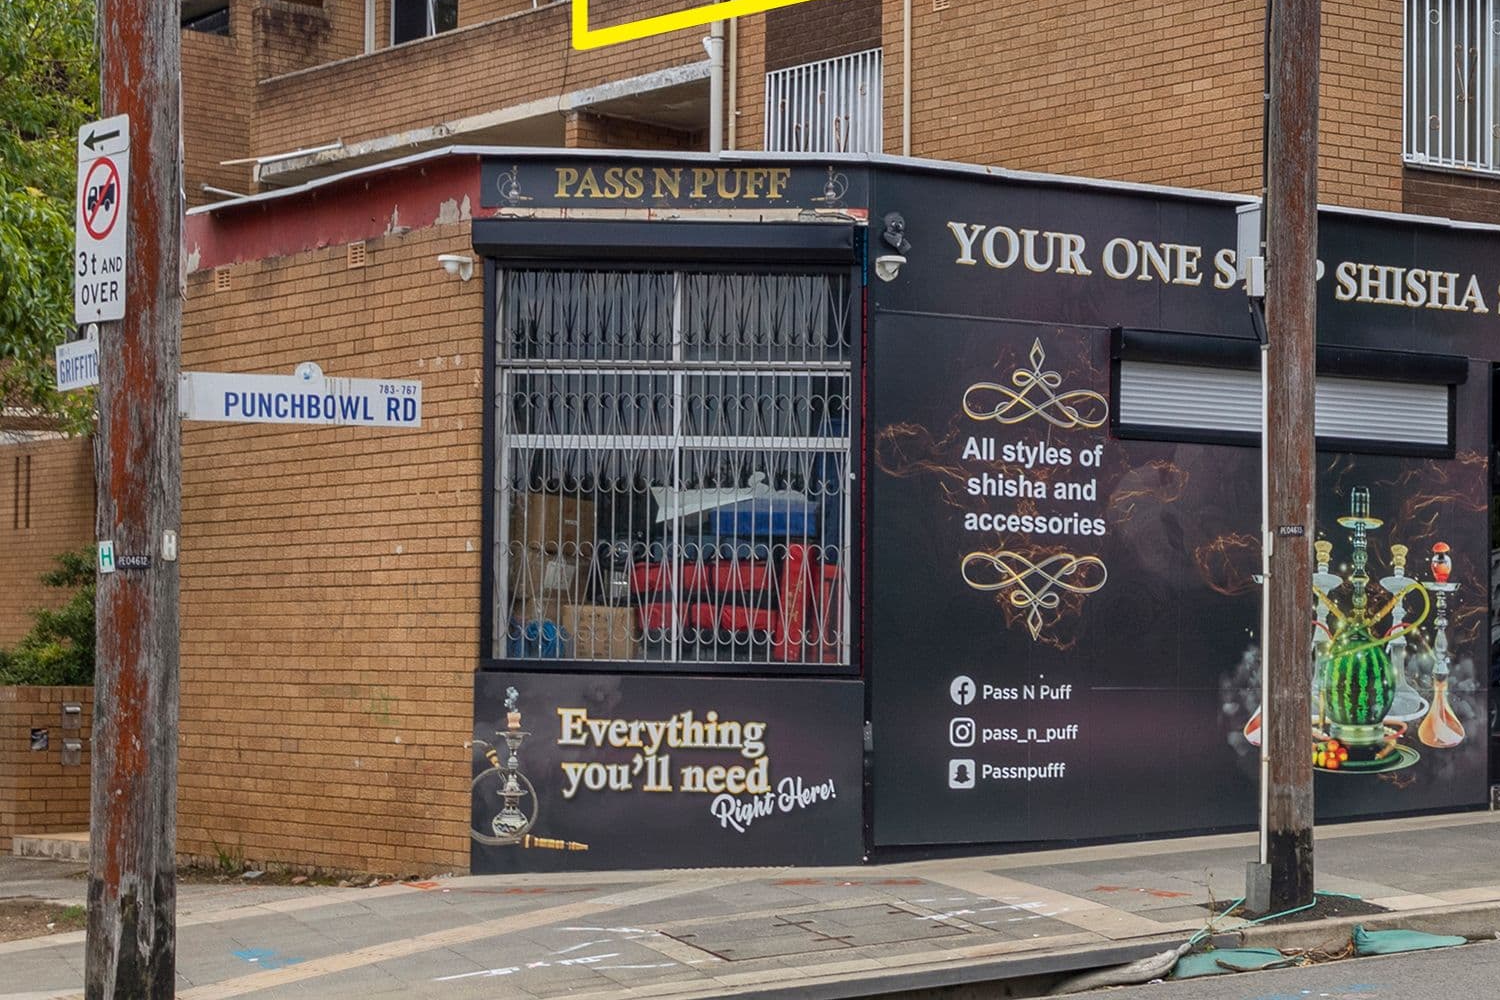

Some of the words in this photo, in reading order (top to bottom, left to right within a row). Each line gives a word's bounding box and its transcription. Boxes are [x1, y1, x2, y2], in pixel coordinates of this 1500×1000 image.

[554, 168, 644, 198] PASS
[652, 168, 683, 198] N
[690, 168, 790, 198] PUFF
[101, 256, 122, 274] AND
[947, 221, 1092, 276] YOUR
[1102, 237, 1203, 286] ONE
[1335, 261, 1489, 313] SHISHA
[82, 281, 118, 305] OVER
[379, 384, 417, 395] 783-767
[224, 391, 374, 420] PUNCHBOWL
[387, 397, 416, 422] RD
[962, 437, 995, 460] All
[1002, 441, 1072, 468] styles
[1079, 445, 1103, 467] of
[967, 474, 1047, 499] shisha
[1054, 479, 1097, 500] and
[964, 512, 1106, 536] accessories
[101, 547, 112, 566] H
[983, 685, 1018, 700] Pass
[1023, 685, 1035, 700] N
[1040, 685, 1072, 700] Puff
[557, 708, 766, 759] Everything
[982, 724, 1079, 743] pass_n_puff
[561, 754, 672, 798] you'll
[680, 757, 771, 793] need
[982, 763, 1066, 781] Passnpufff
[710, 790, 774, 833] Right
[777, 776, 836, 807] Here!
